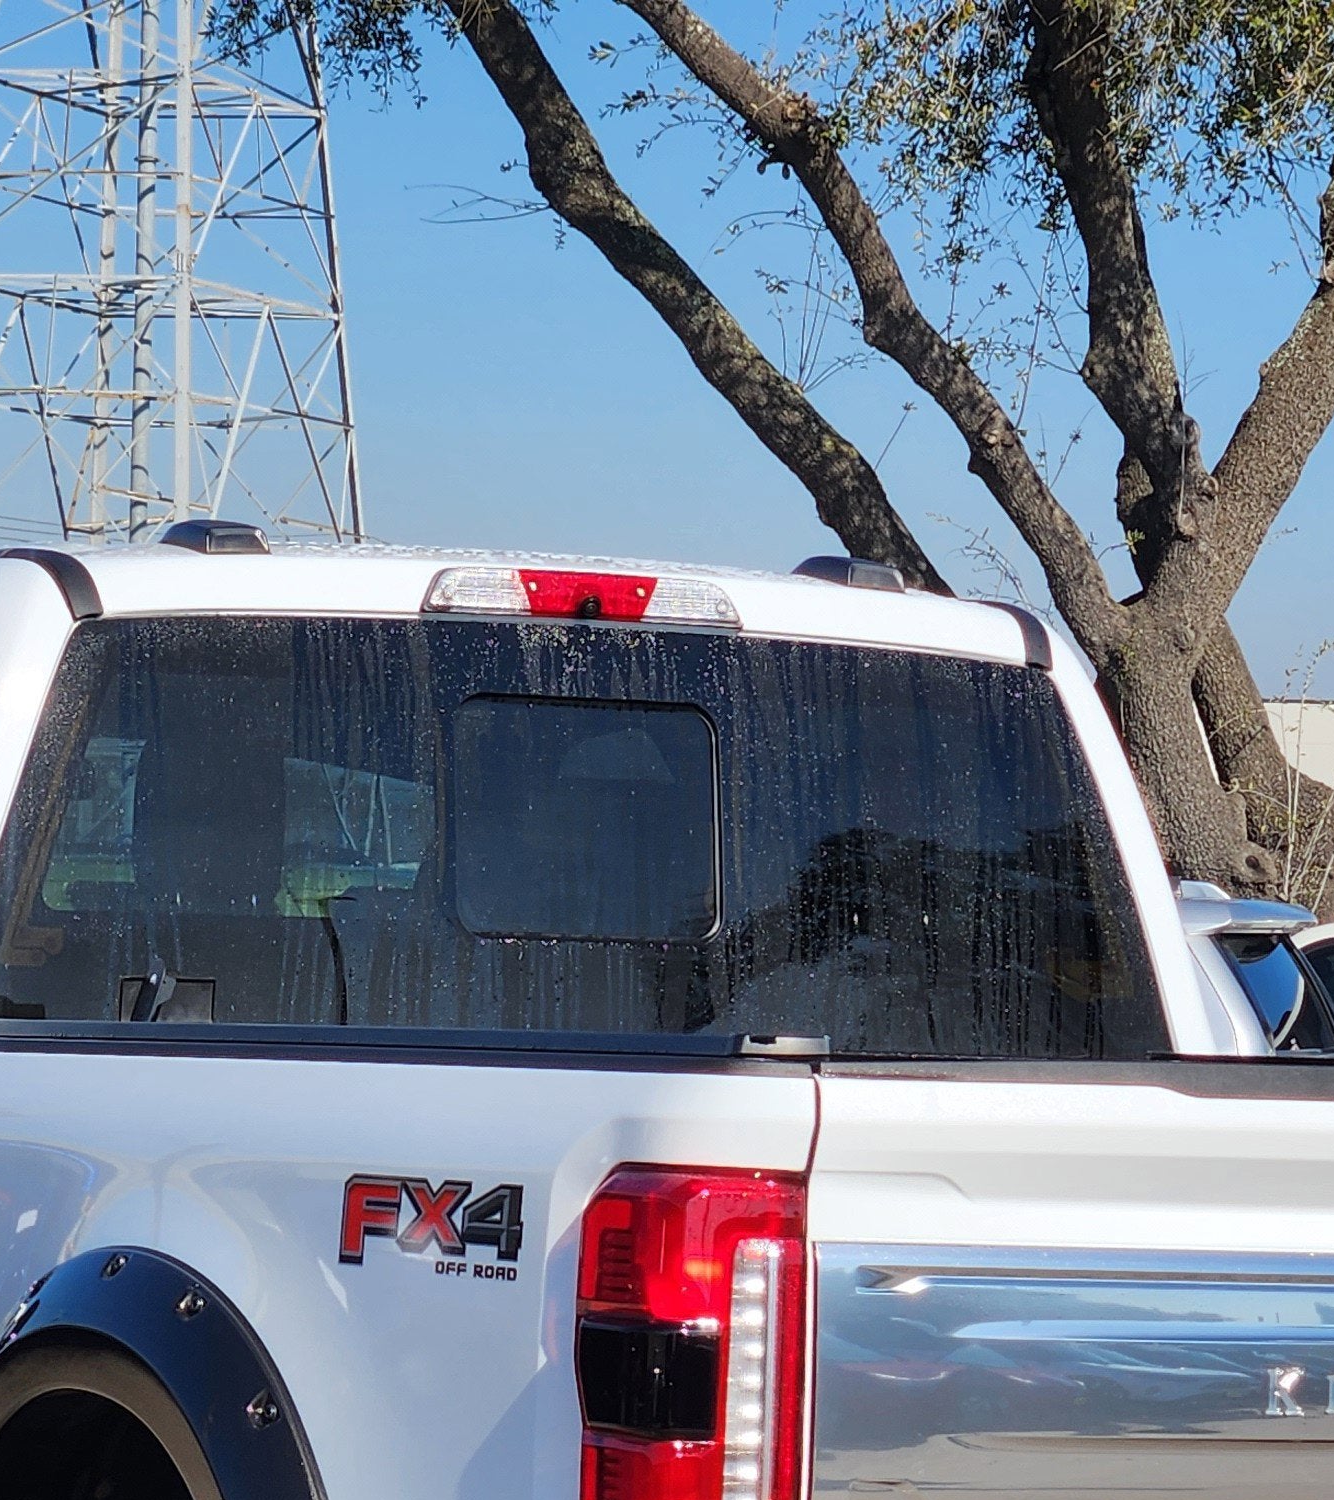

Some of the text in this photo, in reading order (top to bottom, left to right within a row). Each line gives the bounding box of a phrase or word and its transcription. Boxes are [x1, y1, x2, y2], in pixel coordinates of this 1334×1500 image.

[338, 1173, 524, 1266] FX4
[435, 1261, 517, 1281] OFF ROAD
